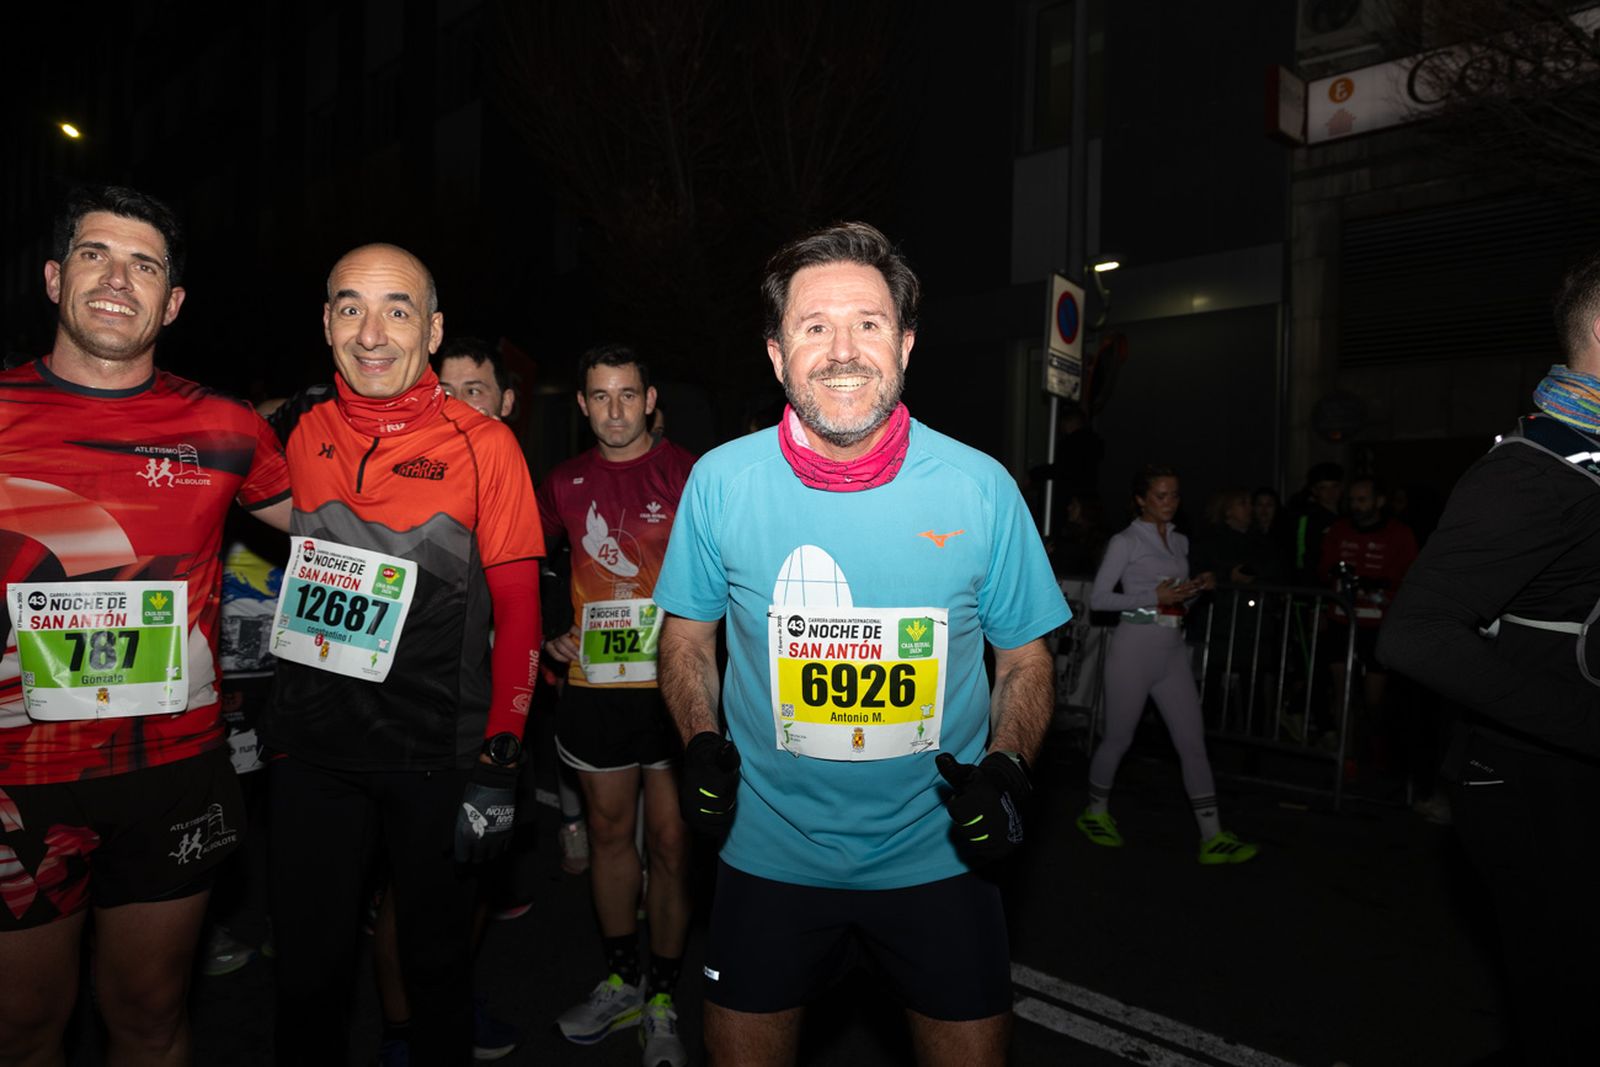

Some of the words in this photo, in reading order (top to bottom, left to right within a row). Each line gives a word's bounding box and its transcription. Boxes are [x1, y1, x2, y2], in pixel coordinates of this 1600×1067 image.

[134, 446, 178, 454] ATLETISMO
[175, 478, 211, 486] ALBOLOTE
[314, 554, 349, 572] NOCHE
[349, 562, 366, 576] DE
[598, 544, 619, 566] 43
[299, 566, 320, 582] SAN
[320, 572, 361, 591] ANTÓN
[29, 595, 46, 606] 43
[50, 597, 104, 611] NOCHE
[107, 597, 127, 610] DE
[296, 583, 390, 636] 12687
[30, 614, 65, 630] SAN
[68, 610, 127, 629] ANTÓN
[597, 609, 619, 618] NOCHE
[621, 609, 631, 618] DE
[788, 620, 805, 631] 43
[808, 624, 859, 639] NOCHE
[862, 625, 882, 639] DE
[64, 630, 140, 672] 787
[600, 629, 640, 655] 752
[788, 642, 822, 658] SAN
[825, 640, 882, 660] ANTÓN
[801, 662, 916, 709] 6926
[830, 711, 869, 723] Antonio
[872, 712, 886, 723] M.
